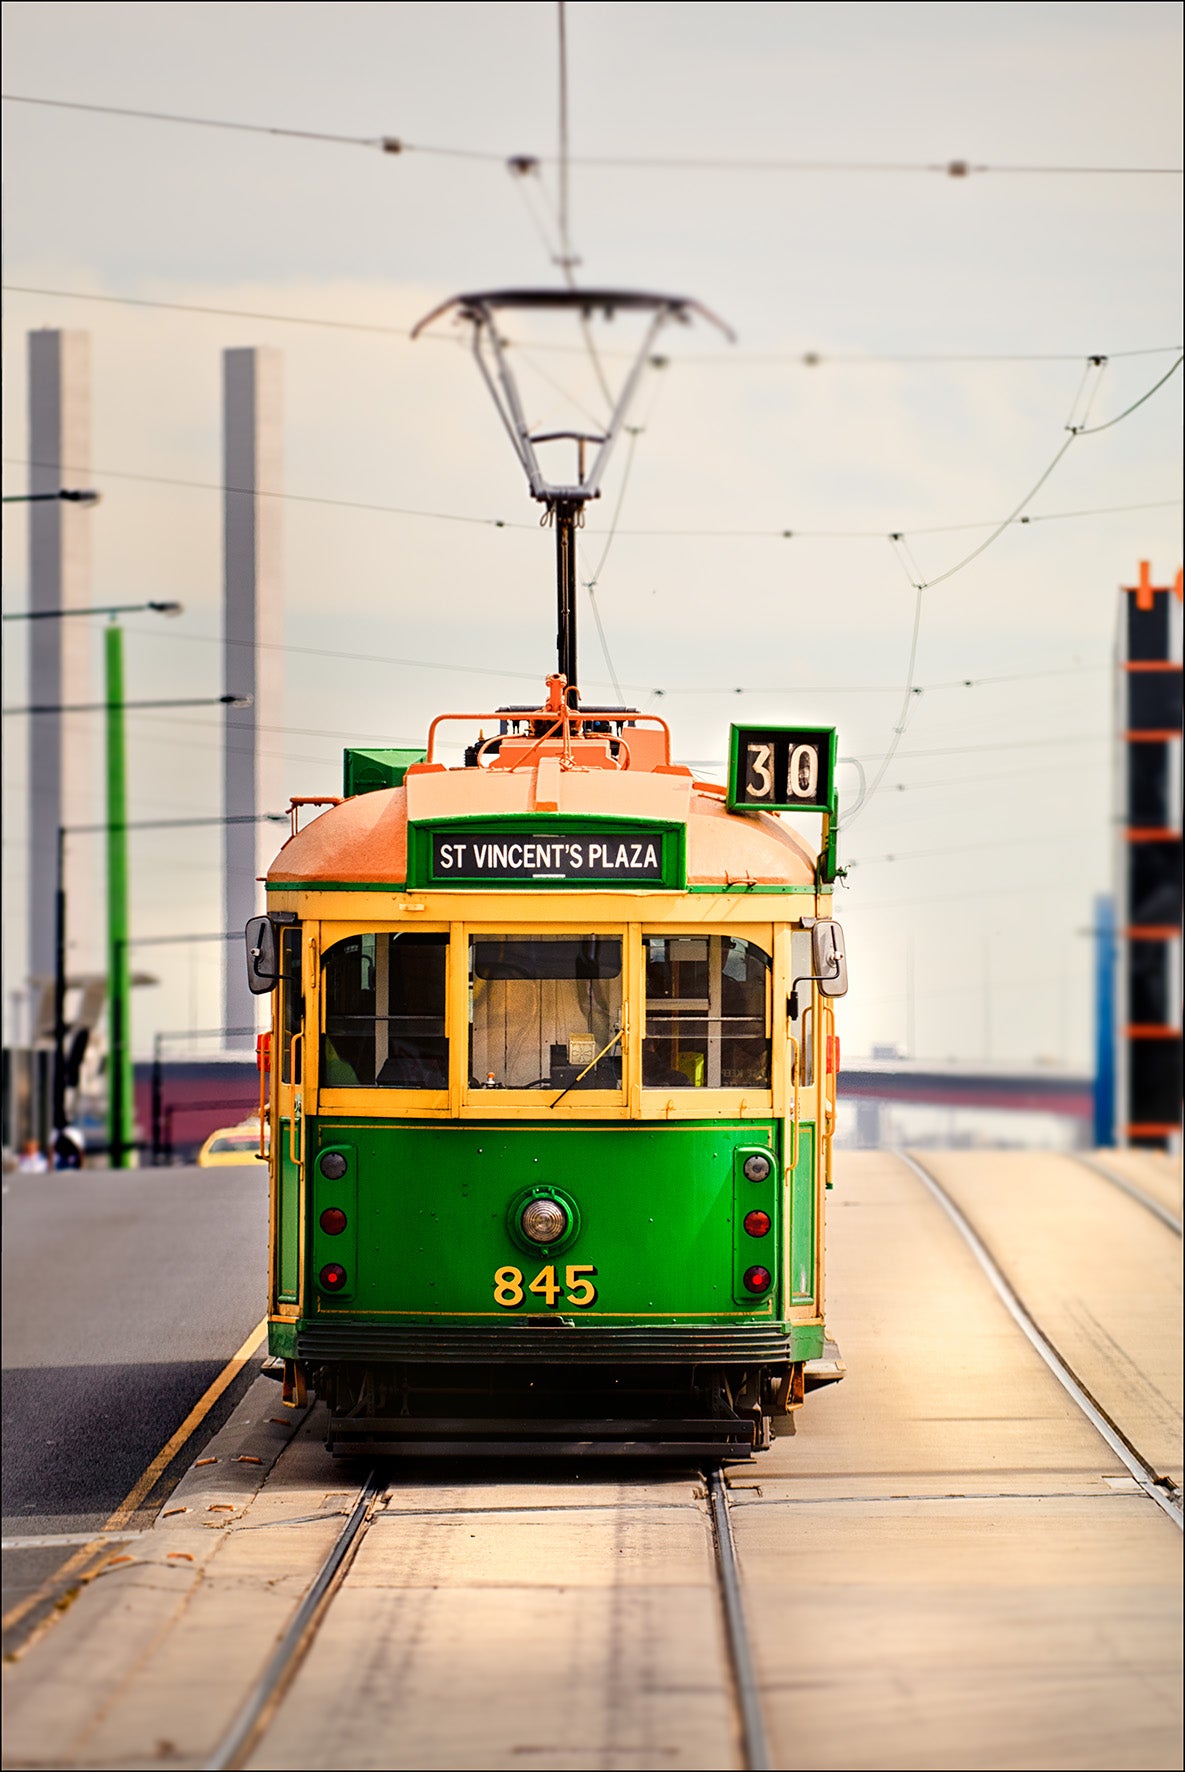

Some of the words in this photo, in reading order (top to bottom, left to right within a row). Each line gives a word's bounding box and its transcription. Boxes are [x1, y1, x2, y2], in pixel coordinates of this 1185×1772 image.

[746, 744, 819, 798] 30
[440, 844, 467, 869] ST
[473, 844, 583, 869] VINCENT'S
[589, 844, 658, 868] PLAZA
[493, 1264, 597, 1308] 845
